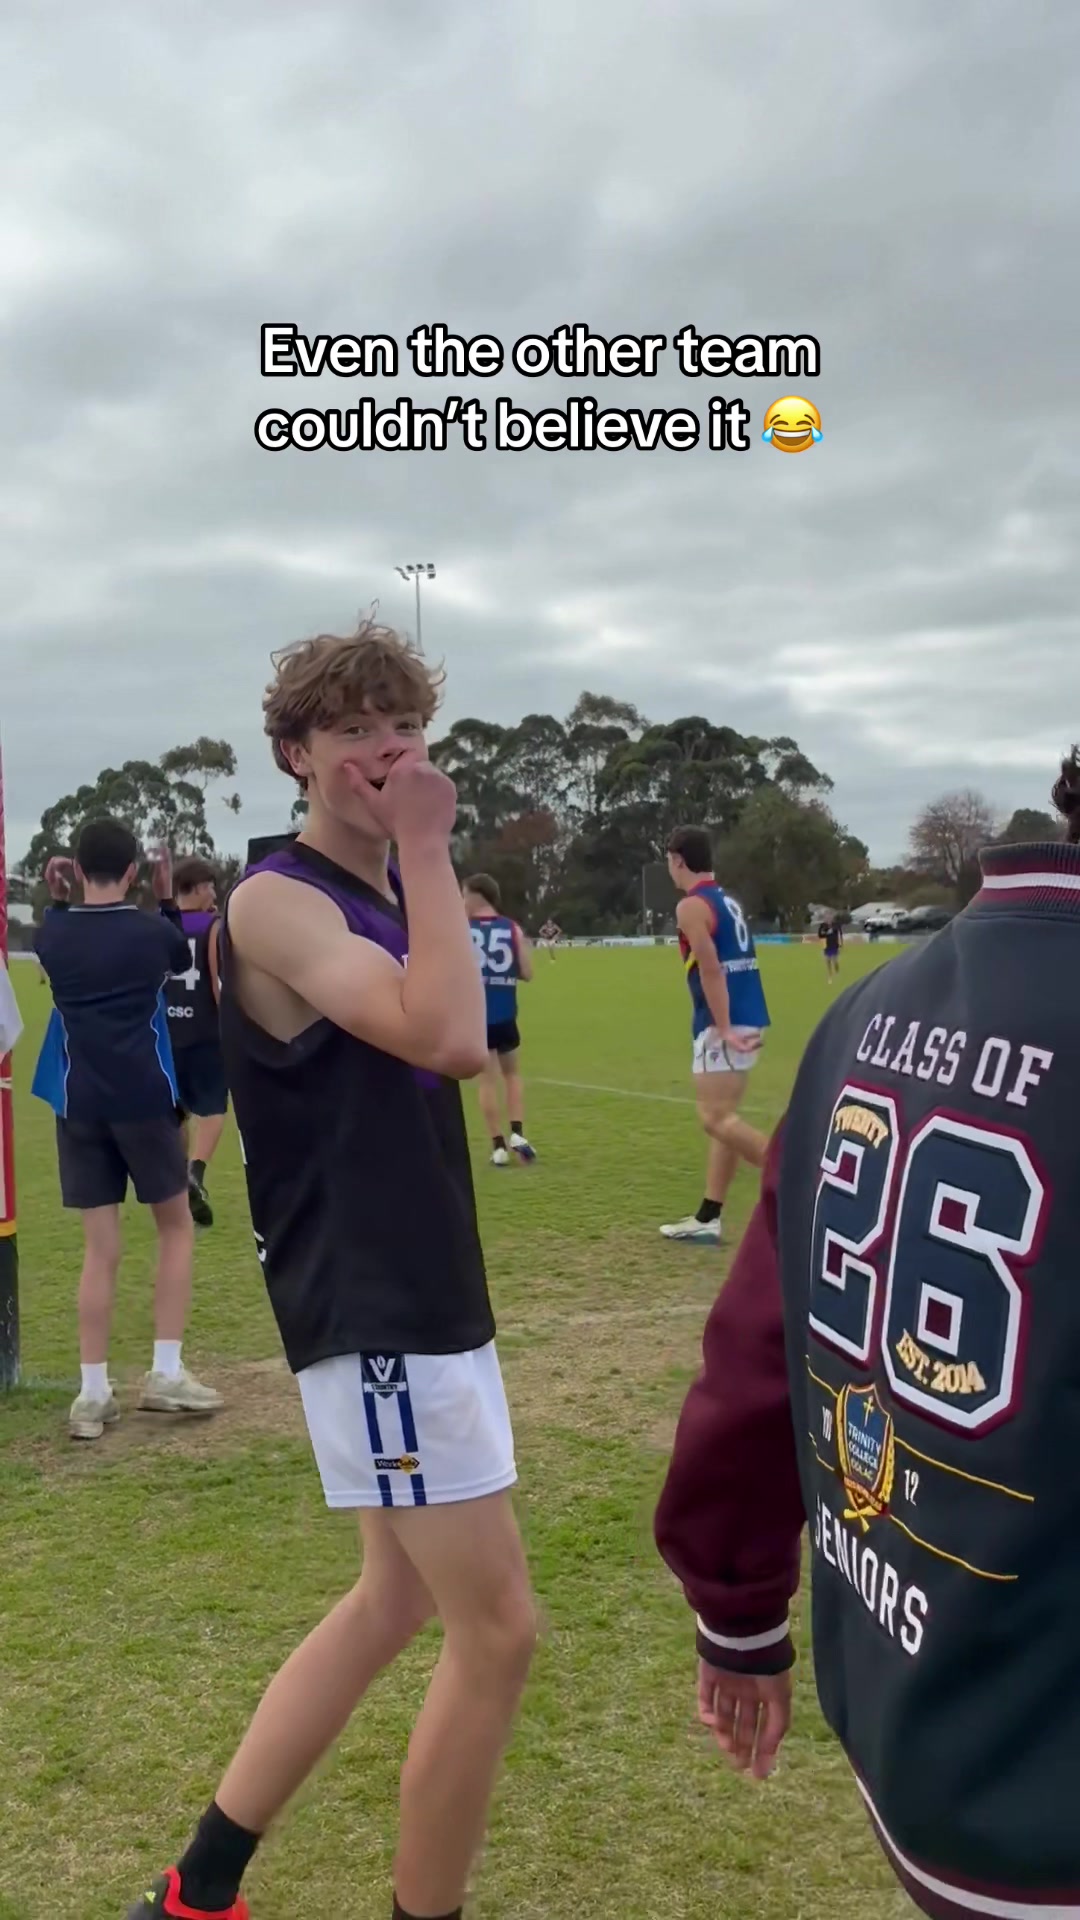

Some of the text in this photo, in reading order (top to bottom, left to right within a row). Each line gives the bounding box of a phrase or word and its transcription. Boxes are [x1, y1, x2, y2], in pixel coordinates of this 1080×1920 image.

[723, 895, 749, 952] 8
[167, 1005, 195, 1018] CSC
[856, 1013, 1054, 1108] CLASS OF
[806, 1083, 1046, 1432] 26
[930, 1360, 987, 1394] 2014
[848, 1420, 882, 1457] TRINITY
[848, 1440, 879, 1471] COLLEGE
[904, 1469, 920, 1507] 12
[815, 1491, 928, 1656] SENIORS
